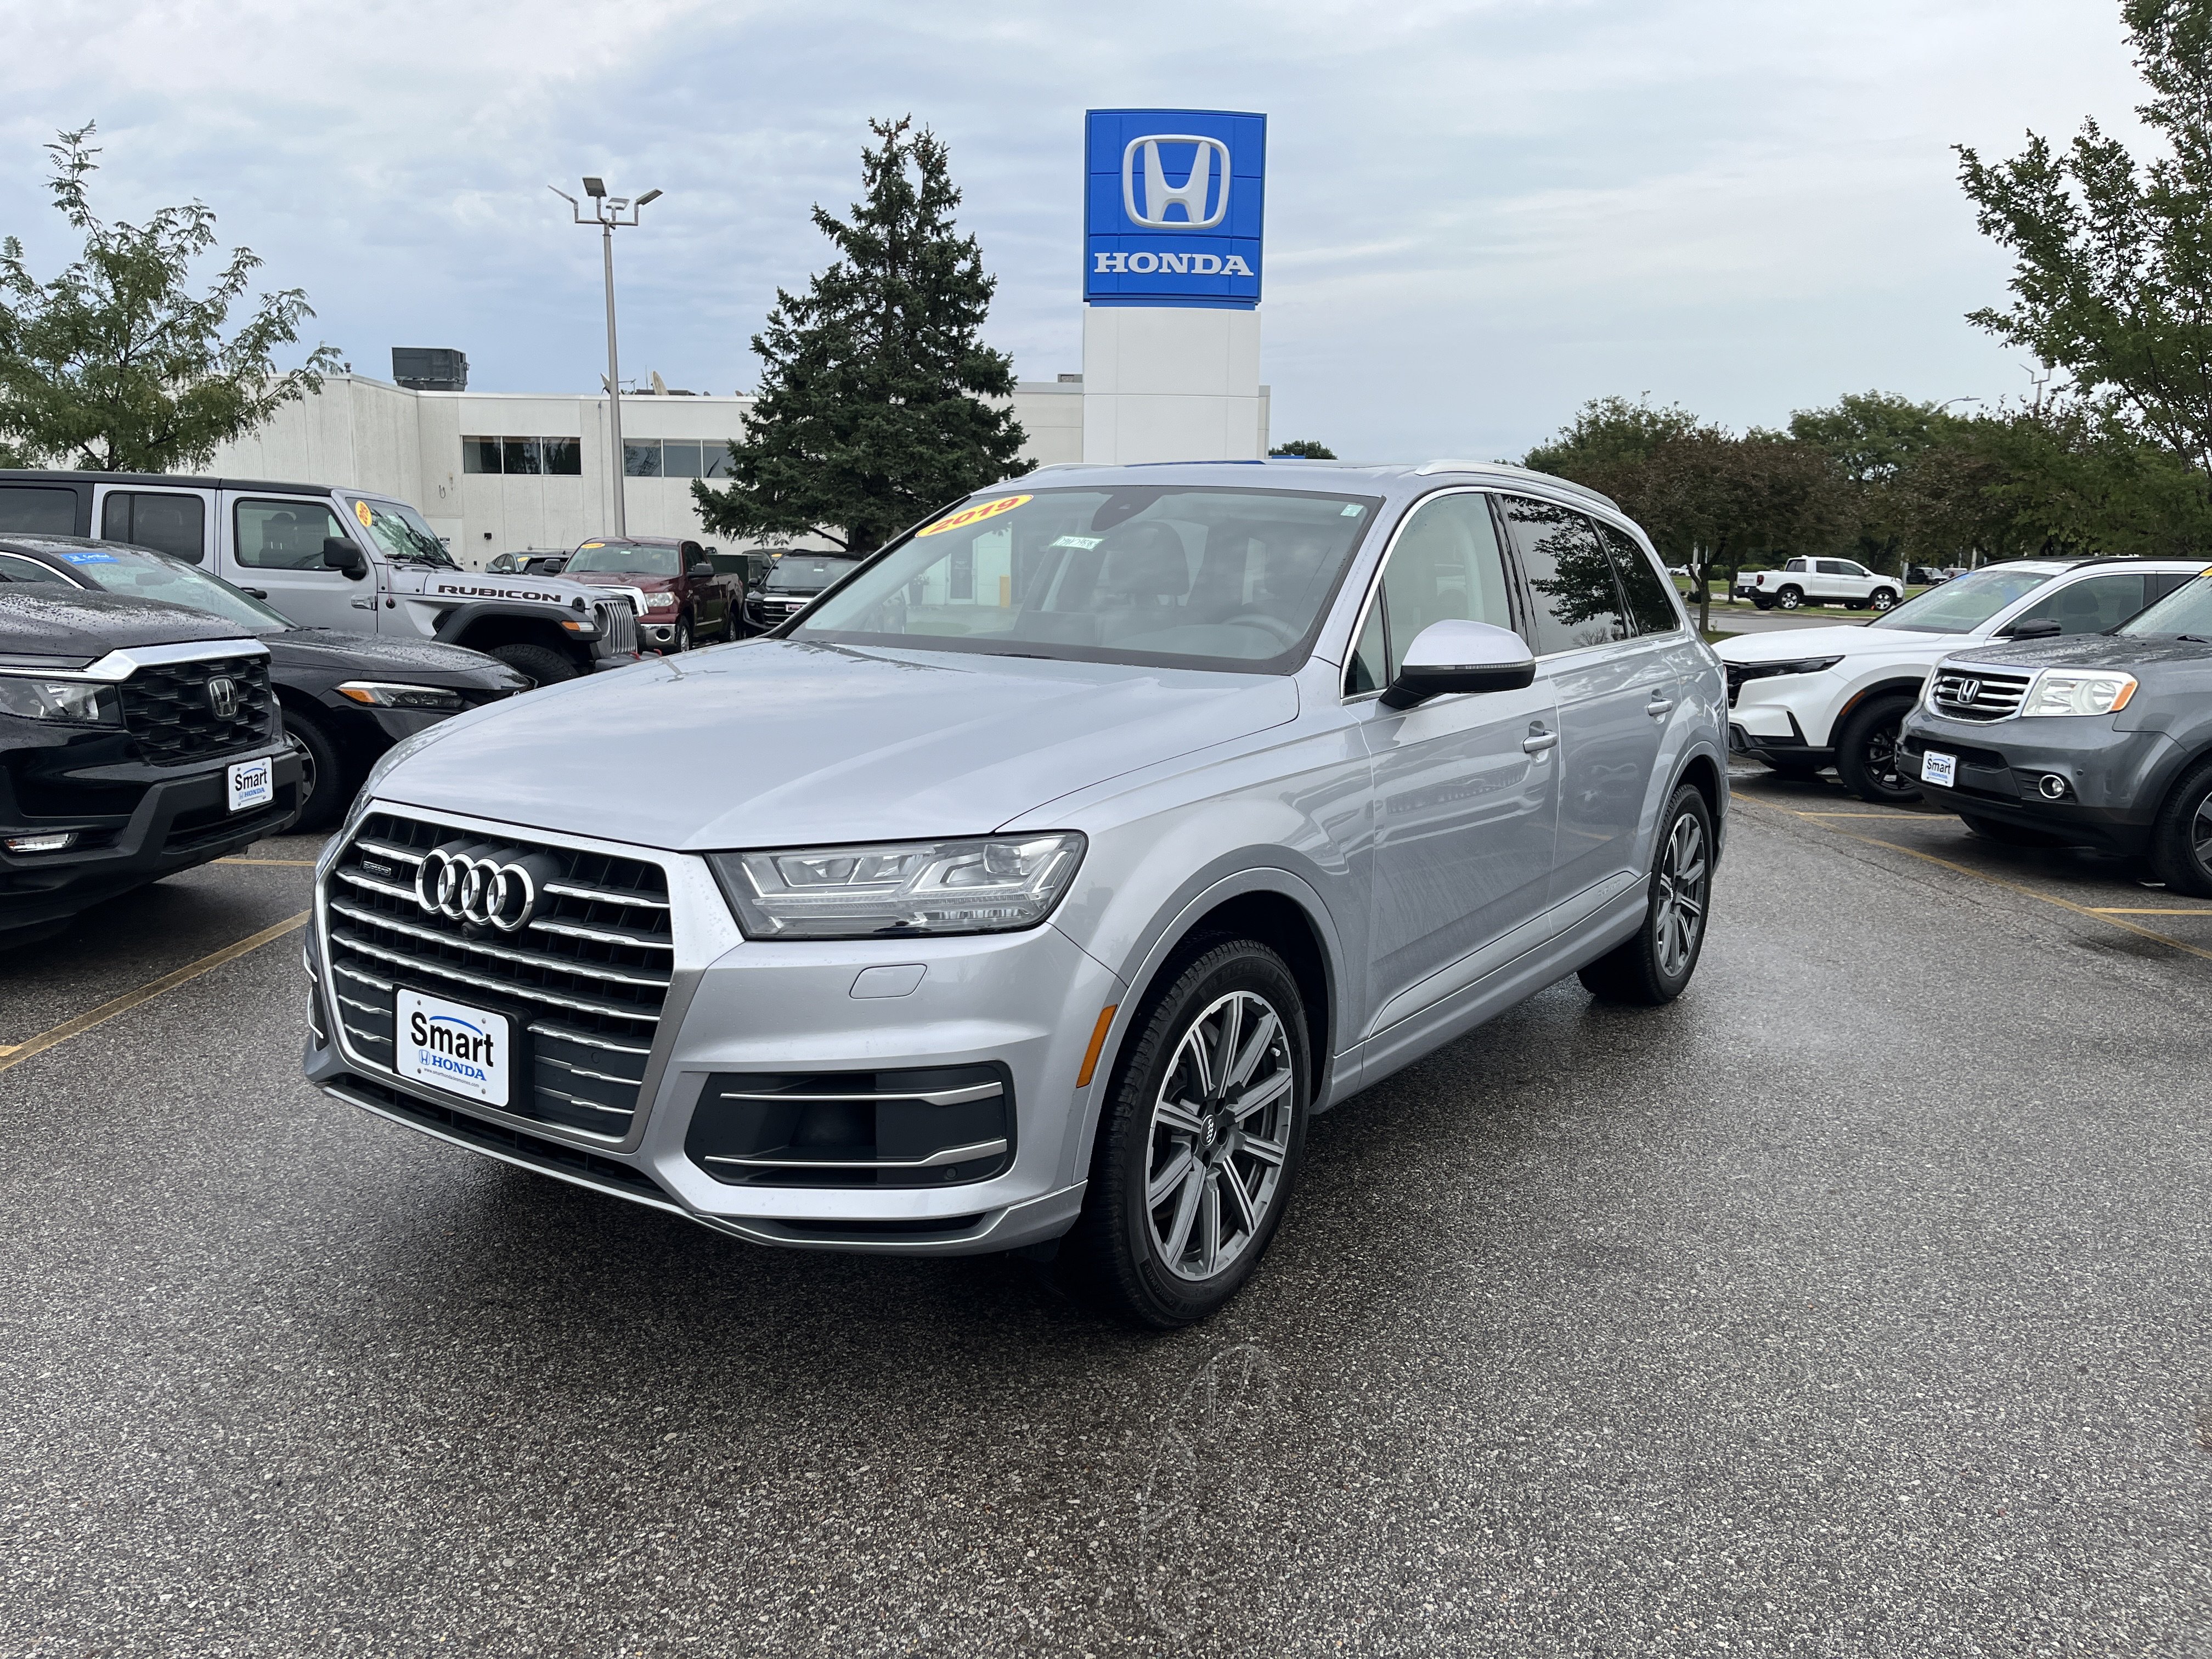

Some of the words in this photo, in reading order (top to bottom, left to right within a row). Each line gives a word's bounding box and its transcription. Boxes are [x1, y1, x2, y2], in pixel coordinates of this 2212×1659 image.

[1094, 252, 1254, 276] HONDA
[928, 498, 1019, 535] 2019
[438, 585, 561, 602] RUBICON
[1927, 758, 1951, 775] Smart
[235, 768, 267, 792] Smart
[244, 787, 265, 797] HONDA
[411, 1011, 494, 1068] Smart
[432, 1054, 487, 1081] HONDA
